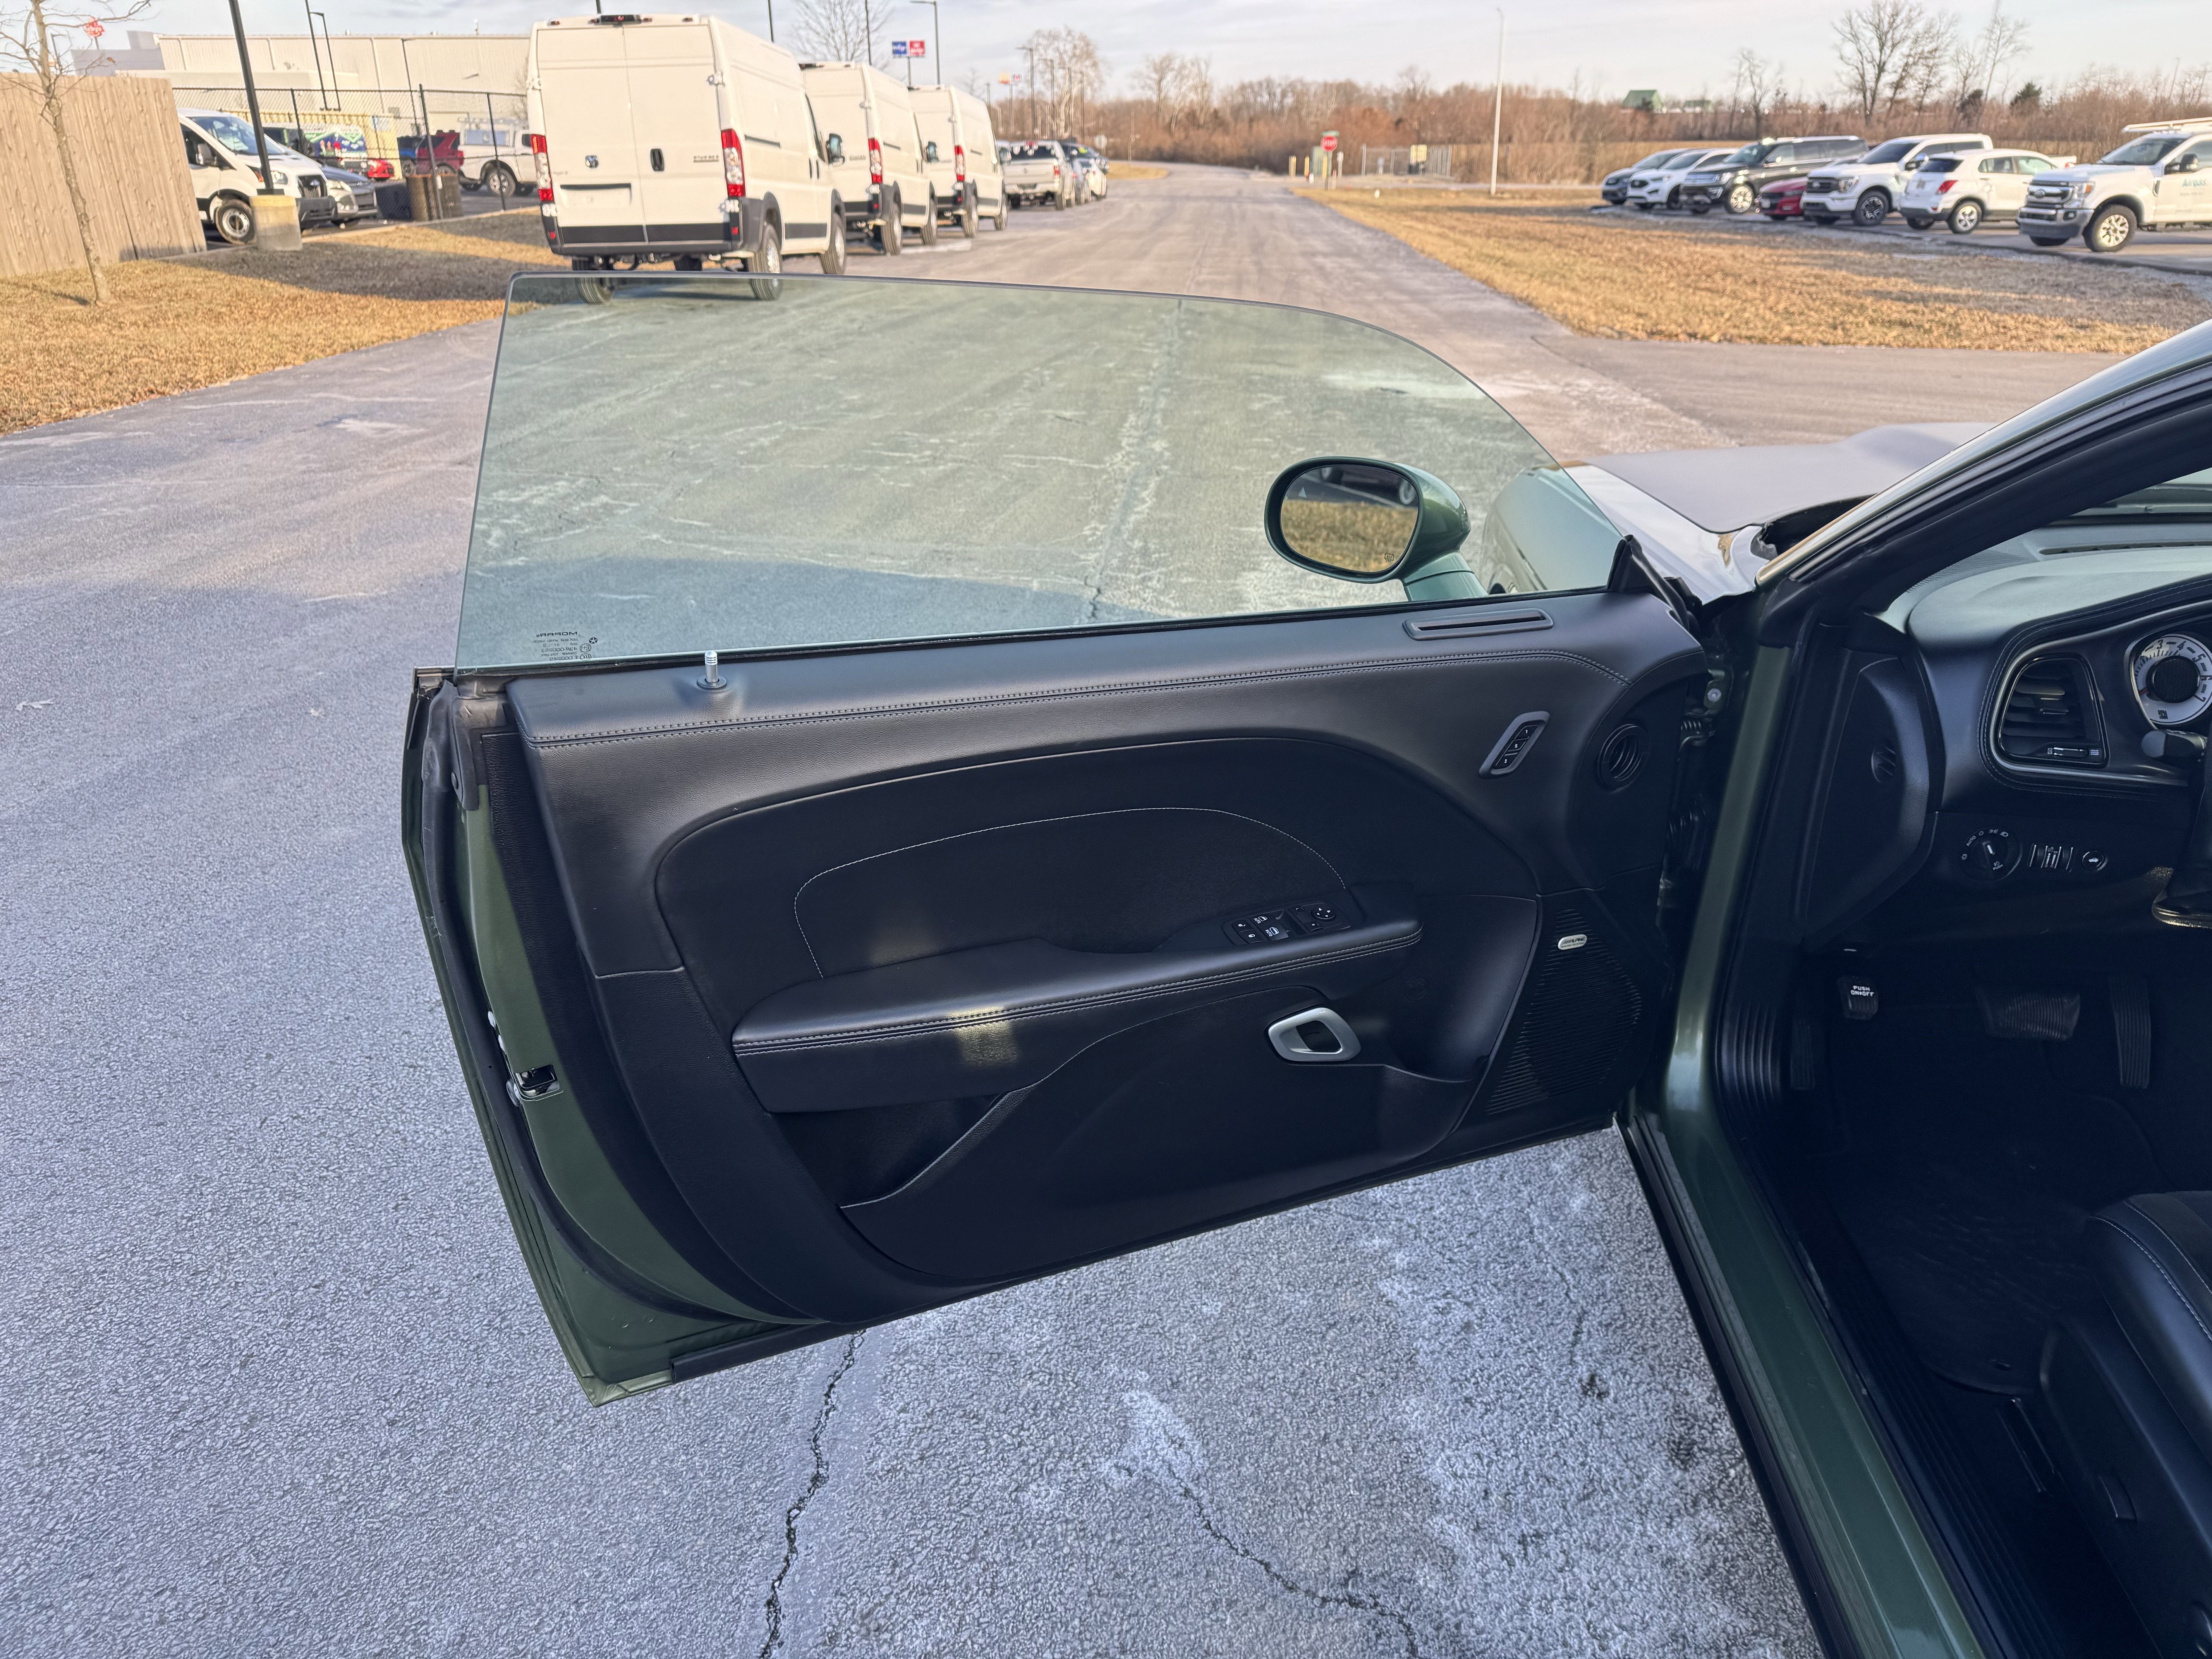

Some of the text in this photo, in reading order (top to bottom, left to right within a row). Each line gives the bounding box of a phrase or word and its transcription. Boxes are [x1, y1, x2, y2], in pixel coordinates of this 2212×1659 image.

[2157, 639, 2163, 649] 3
[2177, 641, 2186, 650] 4
[2192, 653, 2206, 662] 5
[1966, 835, 1976, 847] AUTO
